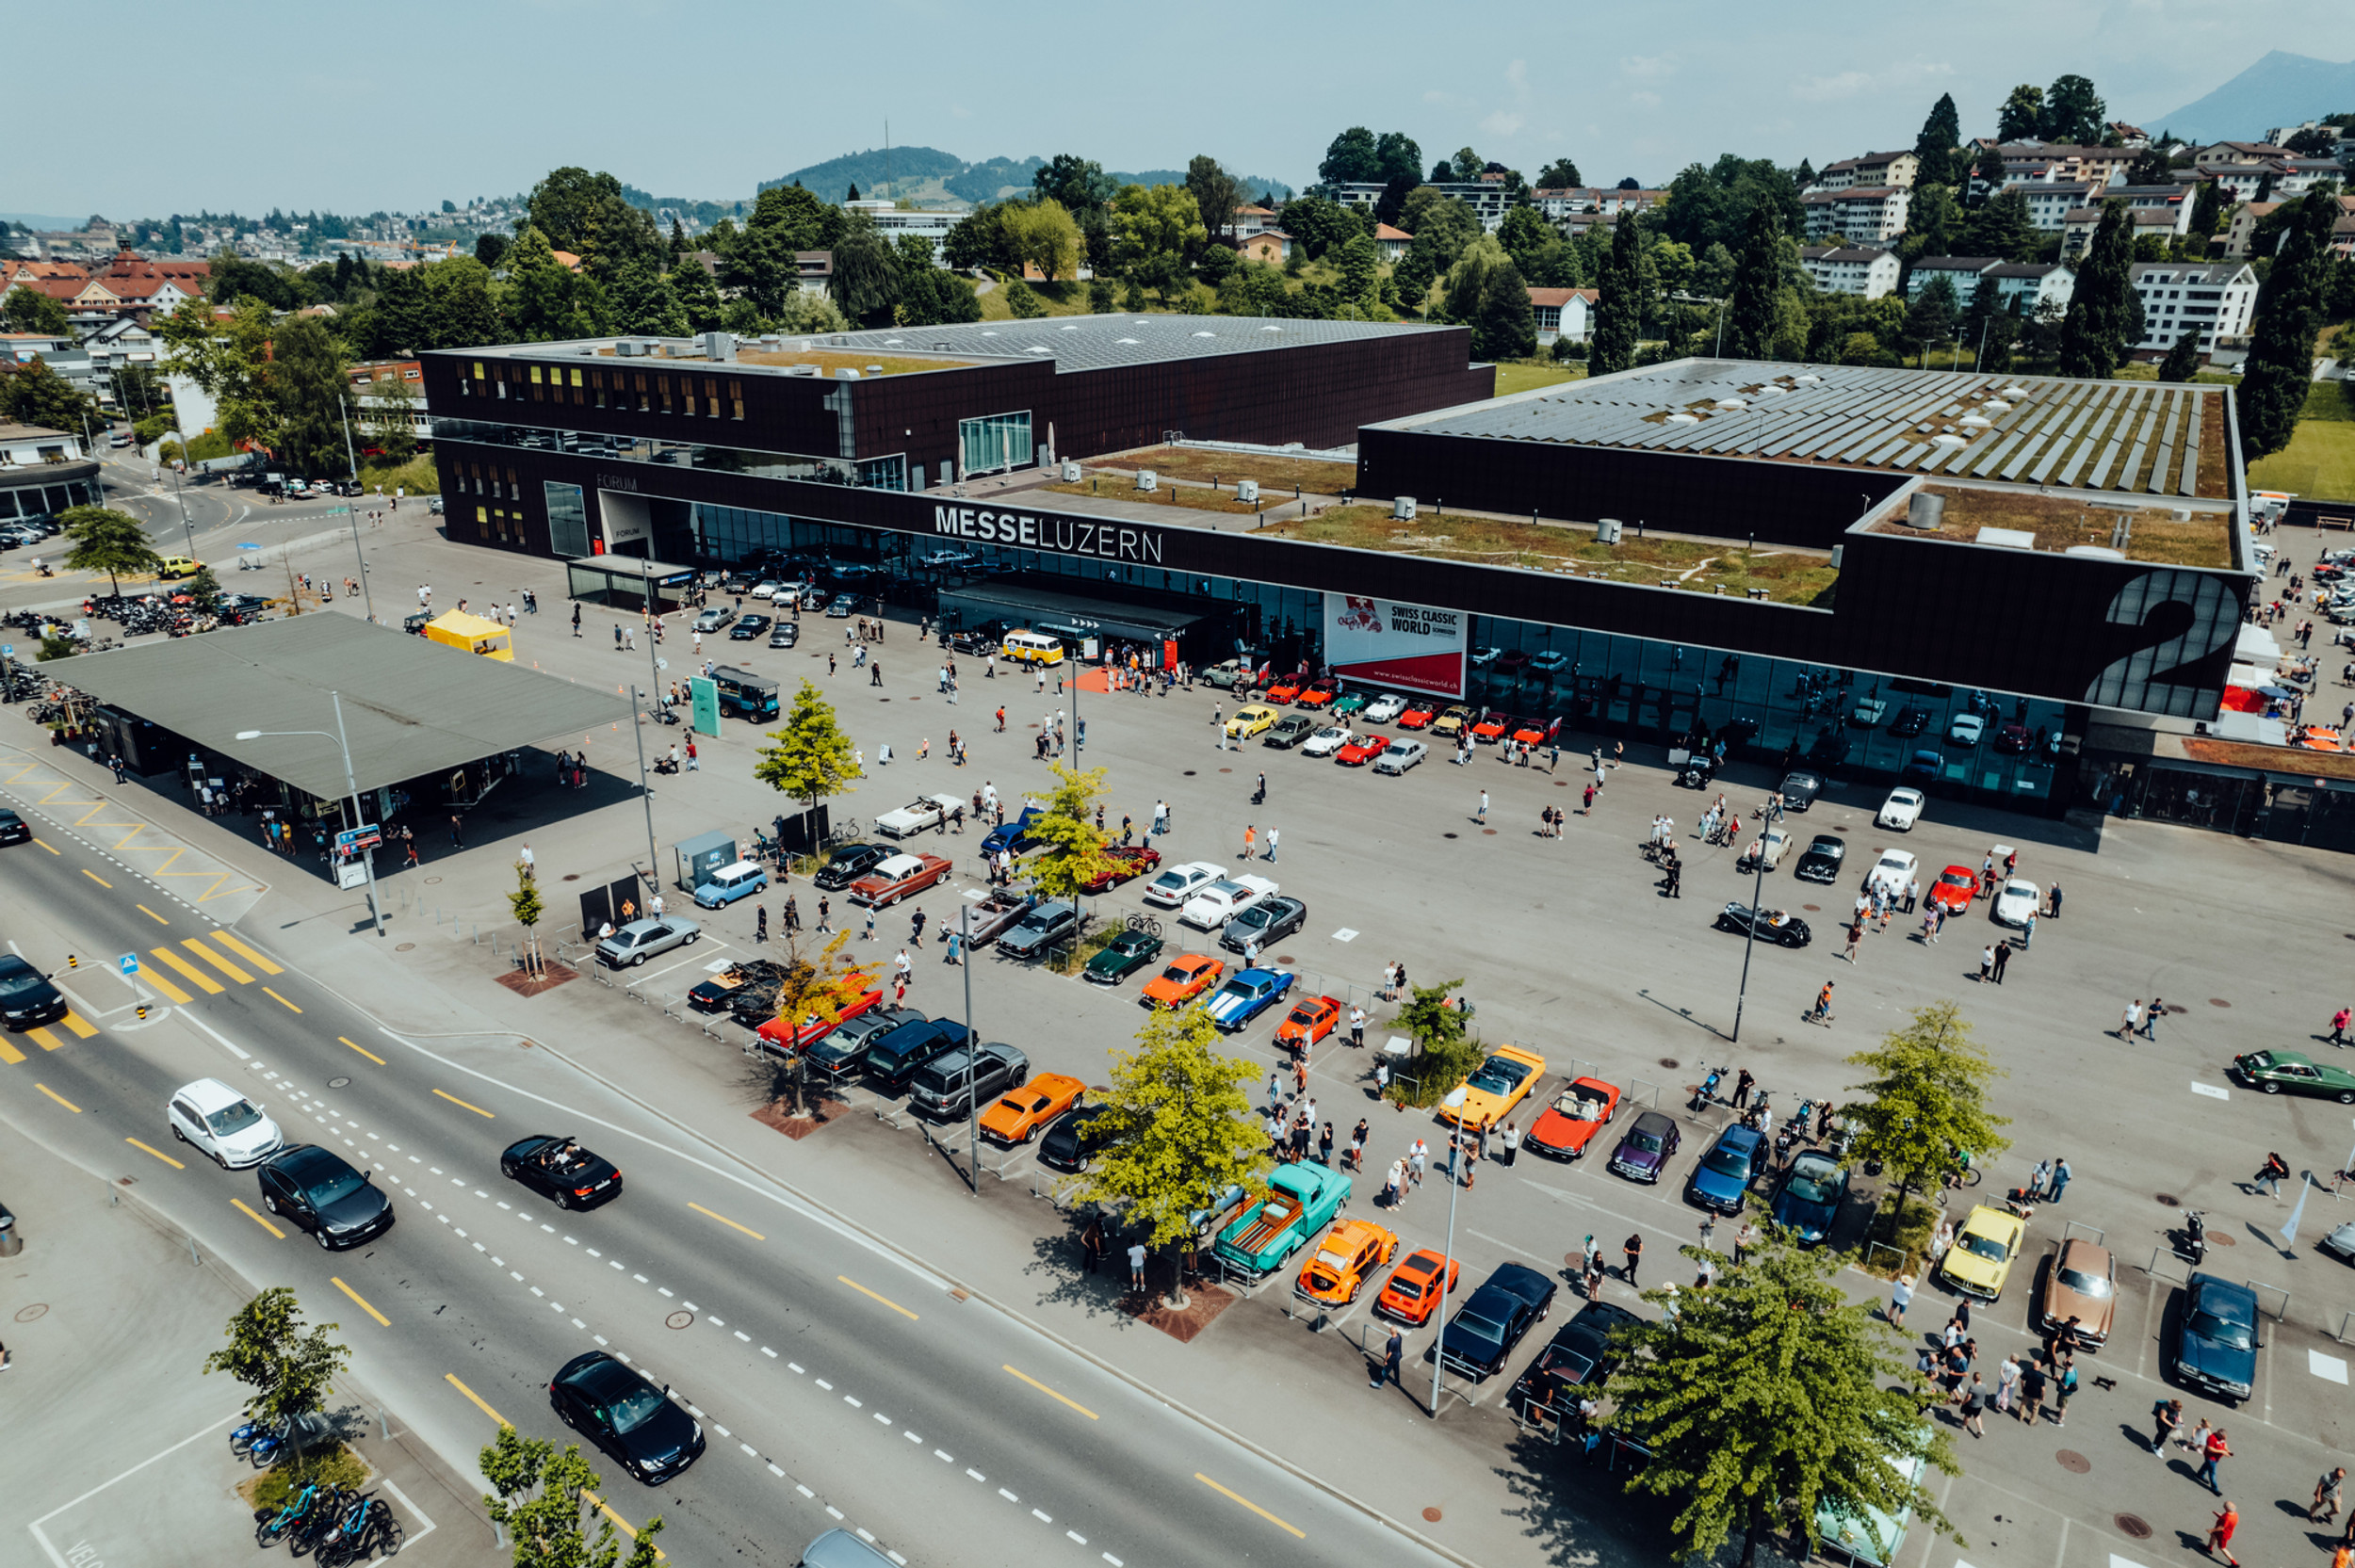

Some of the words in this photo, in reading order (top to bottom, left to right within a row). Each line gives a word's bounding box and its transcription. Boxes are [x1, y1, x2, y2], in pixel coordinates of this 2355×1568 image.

[596, 473, 638, 491] FORUM
[615, 527, 640, 538] FORUM
[1391, 606, 1420, 620] SWISS
[1421, 609, 1457, 625] CLASSIC
[1391, 618, 1431, 635] WORLD
[2084, 570, 2240, 722] 2
[1373, 671, 1458, 688] www.swissclassicworld.ch
